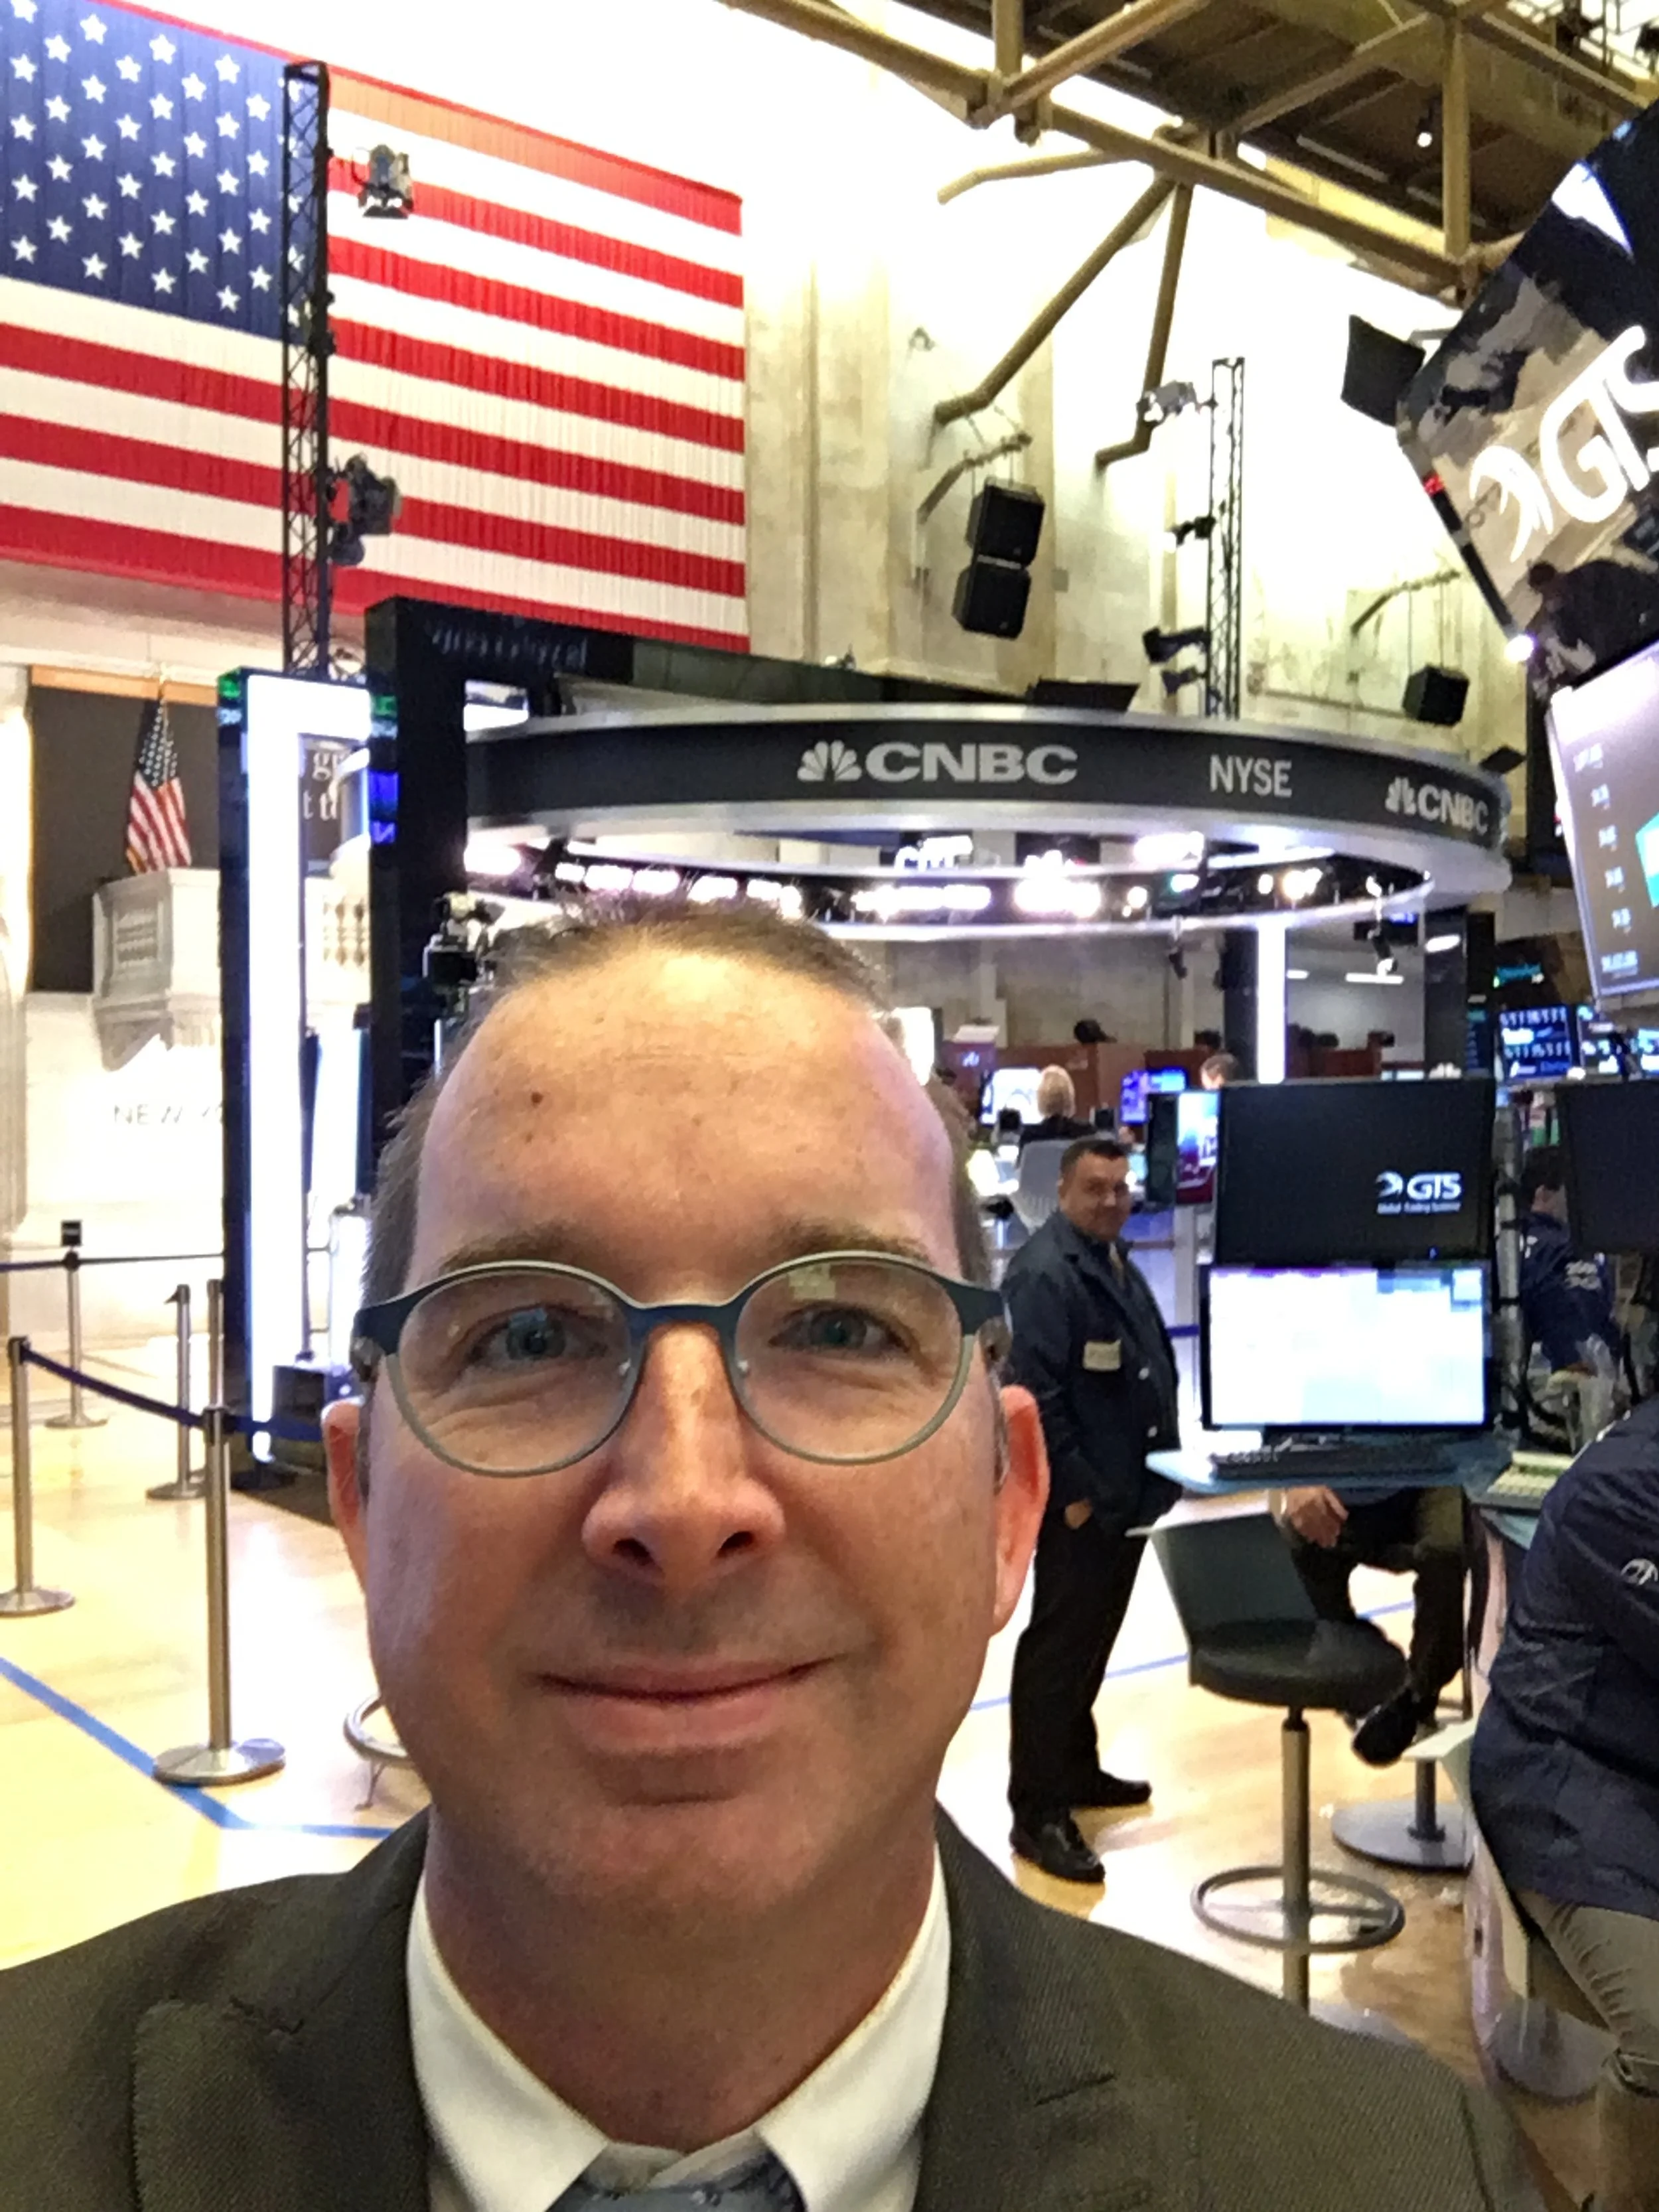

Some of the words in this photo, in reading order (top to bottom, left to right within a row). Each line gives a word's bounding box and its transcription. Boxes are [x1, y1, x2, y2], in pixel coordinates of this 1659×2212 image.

[865, 741, 1078, 784] CNBC
[1209, 754, 1293, 798] NYSE
[1417, 783, 1489, 836] CNBC
[1406, 1171, 1463, 1201] GTS
